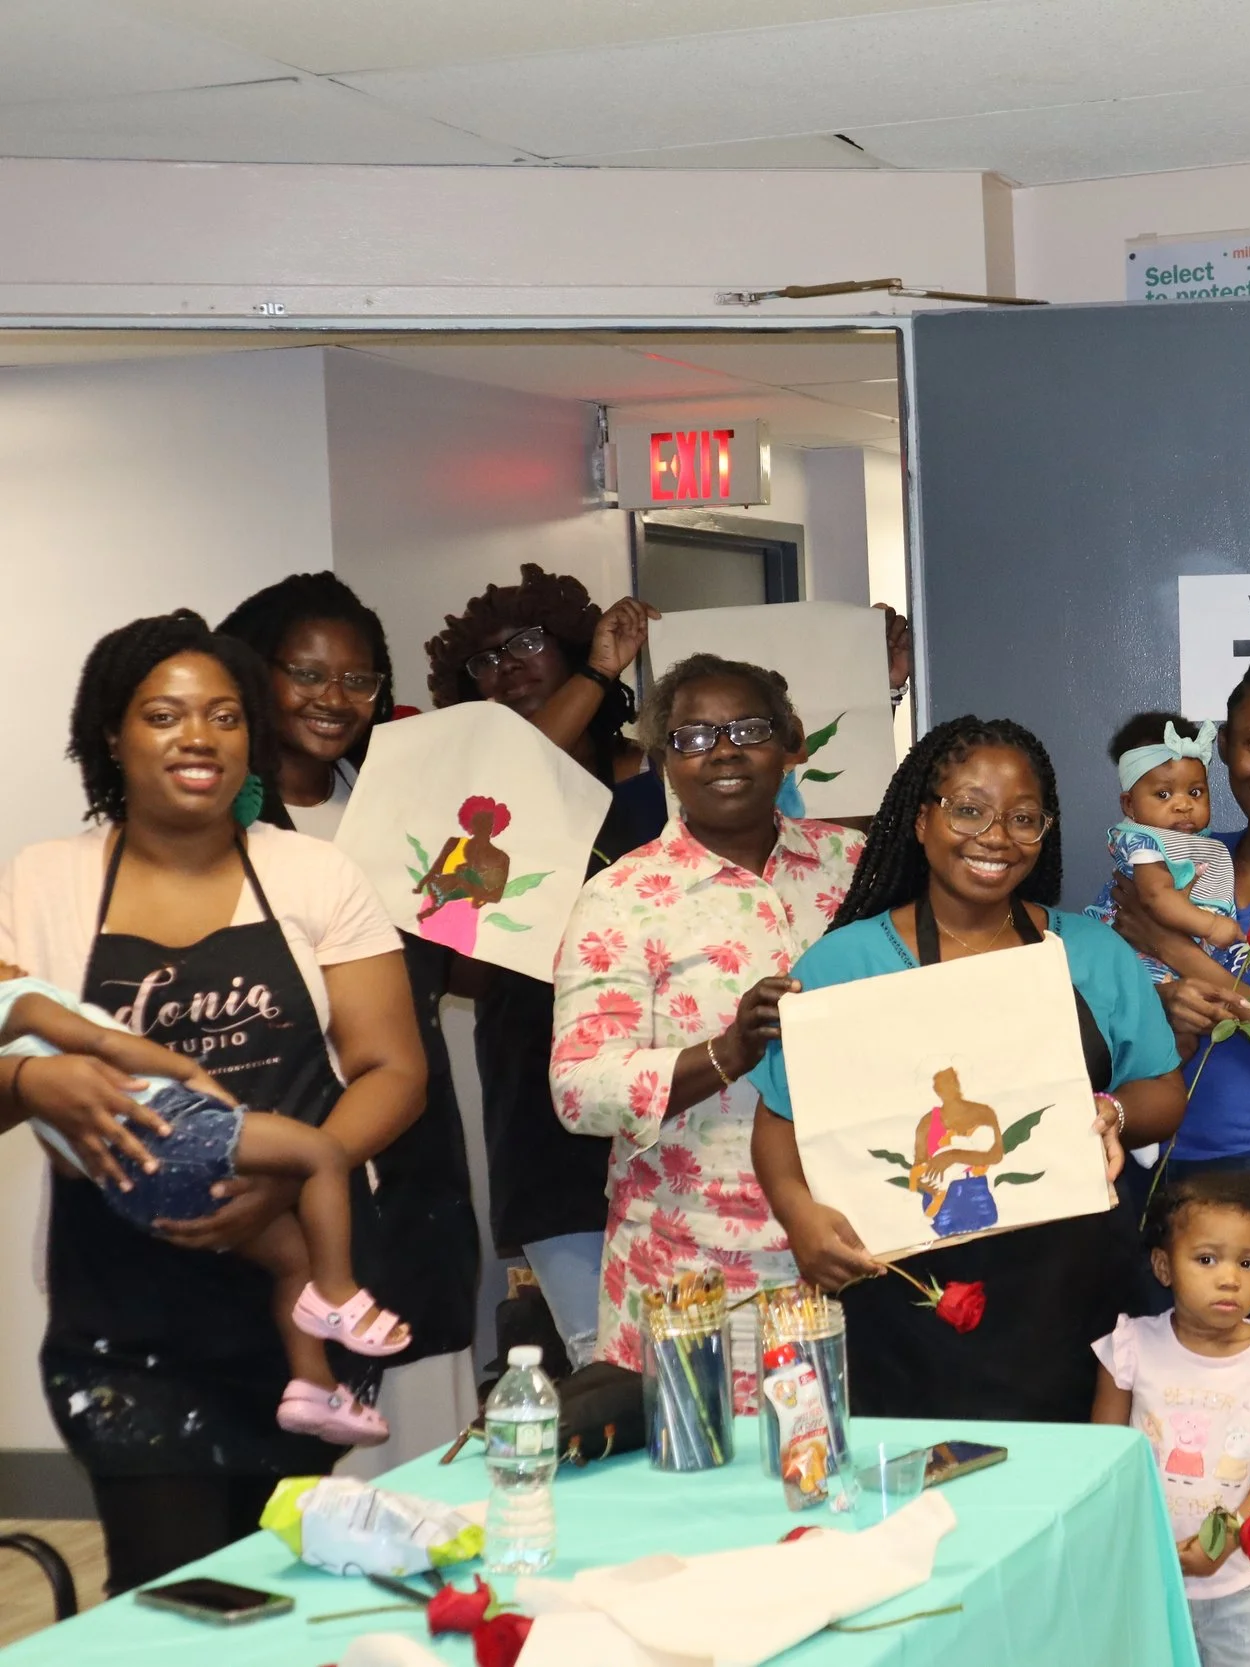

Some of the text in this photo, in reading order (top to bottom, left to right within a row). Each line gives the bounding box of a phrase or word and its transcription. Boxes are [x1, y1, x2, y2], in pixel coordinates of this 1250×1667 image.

[1145, 262, 1214, 287] Select
[651, 430, 734, 500] EXIT
[164, 1031, 248, 1053] TUDIO
